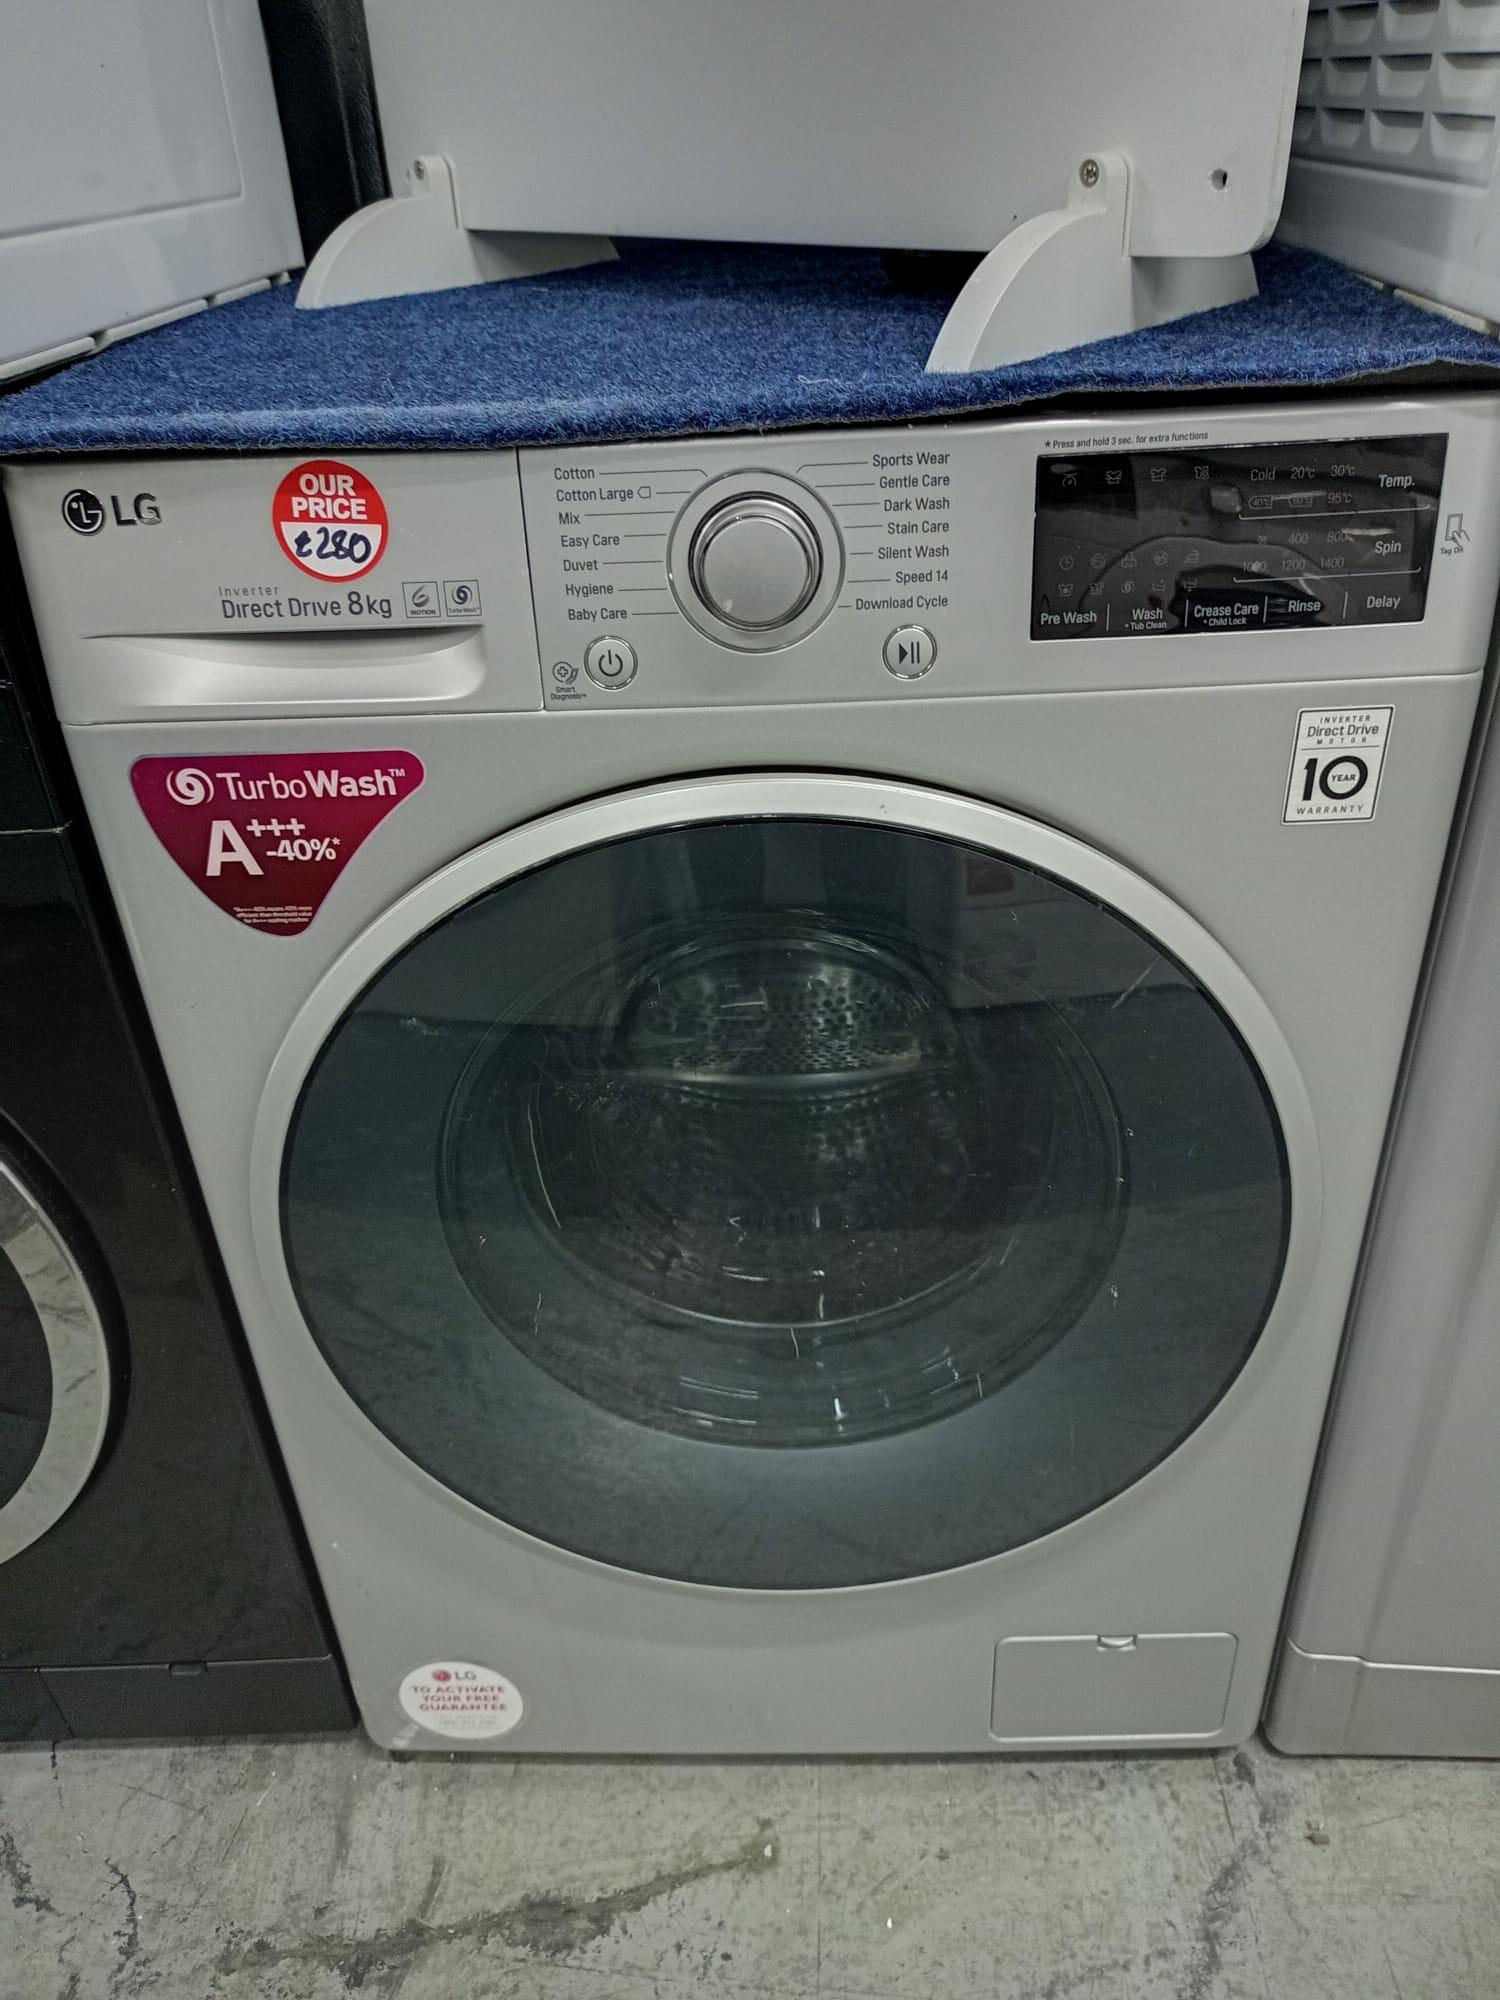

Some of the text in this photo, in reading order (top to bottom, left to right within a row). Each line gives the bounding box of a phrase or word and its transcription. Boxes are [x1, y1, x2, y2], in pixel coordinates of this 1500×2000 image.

[1053, 431, 1209, 449] Press and hold 3 sec. for extra functions
[872, 451, 951, 470] Sports Wear
[554, 467, 595, 480] Cotton
[1250, 467, 1276, 481] Cold
[300, 473, 356, 497] OUR
[879, 474, 950, 488] Gentle Care
[1378, 474, 1416, 489] Temp.
[556, 487, 634, 502] Cotton Large
[110, 492, 163, 526] LG
[292, 496, 367, 520] PRICE
[884, 497, 950, 512] Dark Wash
[558, 511, 581, 525] Mix
[887, 520, 950, 535] Stain Care
[560, 533, 621, 549] Easy Care
[1287, 532, 1309, 545] 400
[878, 544, 950, 560] Silent Wash
[1375, 540, 1402, 556] Spin
[1440, 547, 1453, 555] Tag
[562, 559, 599, 572] Duvet
[1281, 558, 1306, 571] 1200
[1319, 556, 1346, 569] 1400
[895, 568, 949, 586] Speed 14
[218, 586, 281, 598] Inverter
[565, 583, 614, 598] Hygiene
[221, 591, 393, 619] Direct Drive 8kg
[855, 595, 949, 611] Download Cycle
[1288, 599, 1321, 613] Rinse
[1366, 595, 1400, 609] Delay
[567, 607, 628, 623] Baby Care
[1132, 607, 1164, 620] Wash
[1193, 602, 1259, 618] Crease Care
[1040, 611, 1098, 625] Pre Wash
[1131, 620, 1167, 630] Tub Clean
[1208, 616, 1247, 627] Child Lock
[1319, 714, 1371, 724] INVERTER
[1307, 724, 1379, 738] Direct Drive
[1316, 736, 1367, 745] MOTOR
[1301, 755, 1369, 801] 10 YEAR
[1296, 804, 1364, 815] WARRANTY
[454, 1671, 477, 1681] LG
[412, 1685, 505, 1694] TO ACTIVATE
[466, 1694, 500, 1702] FREE
[419, 1703, 508, 1711] GUARANTEE
